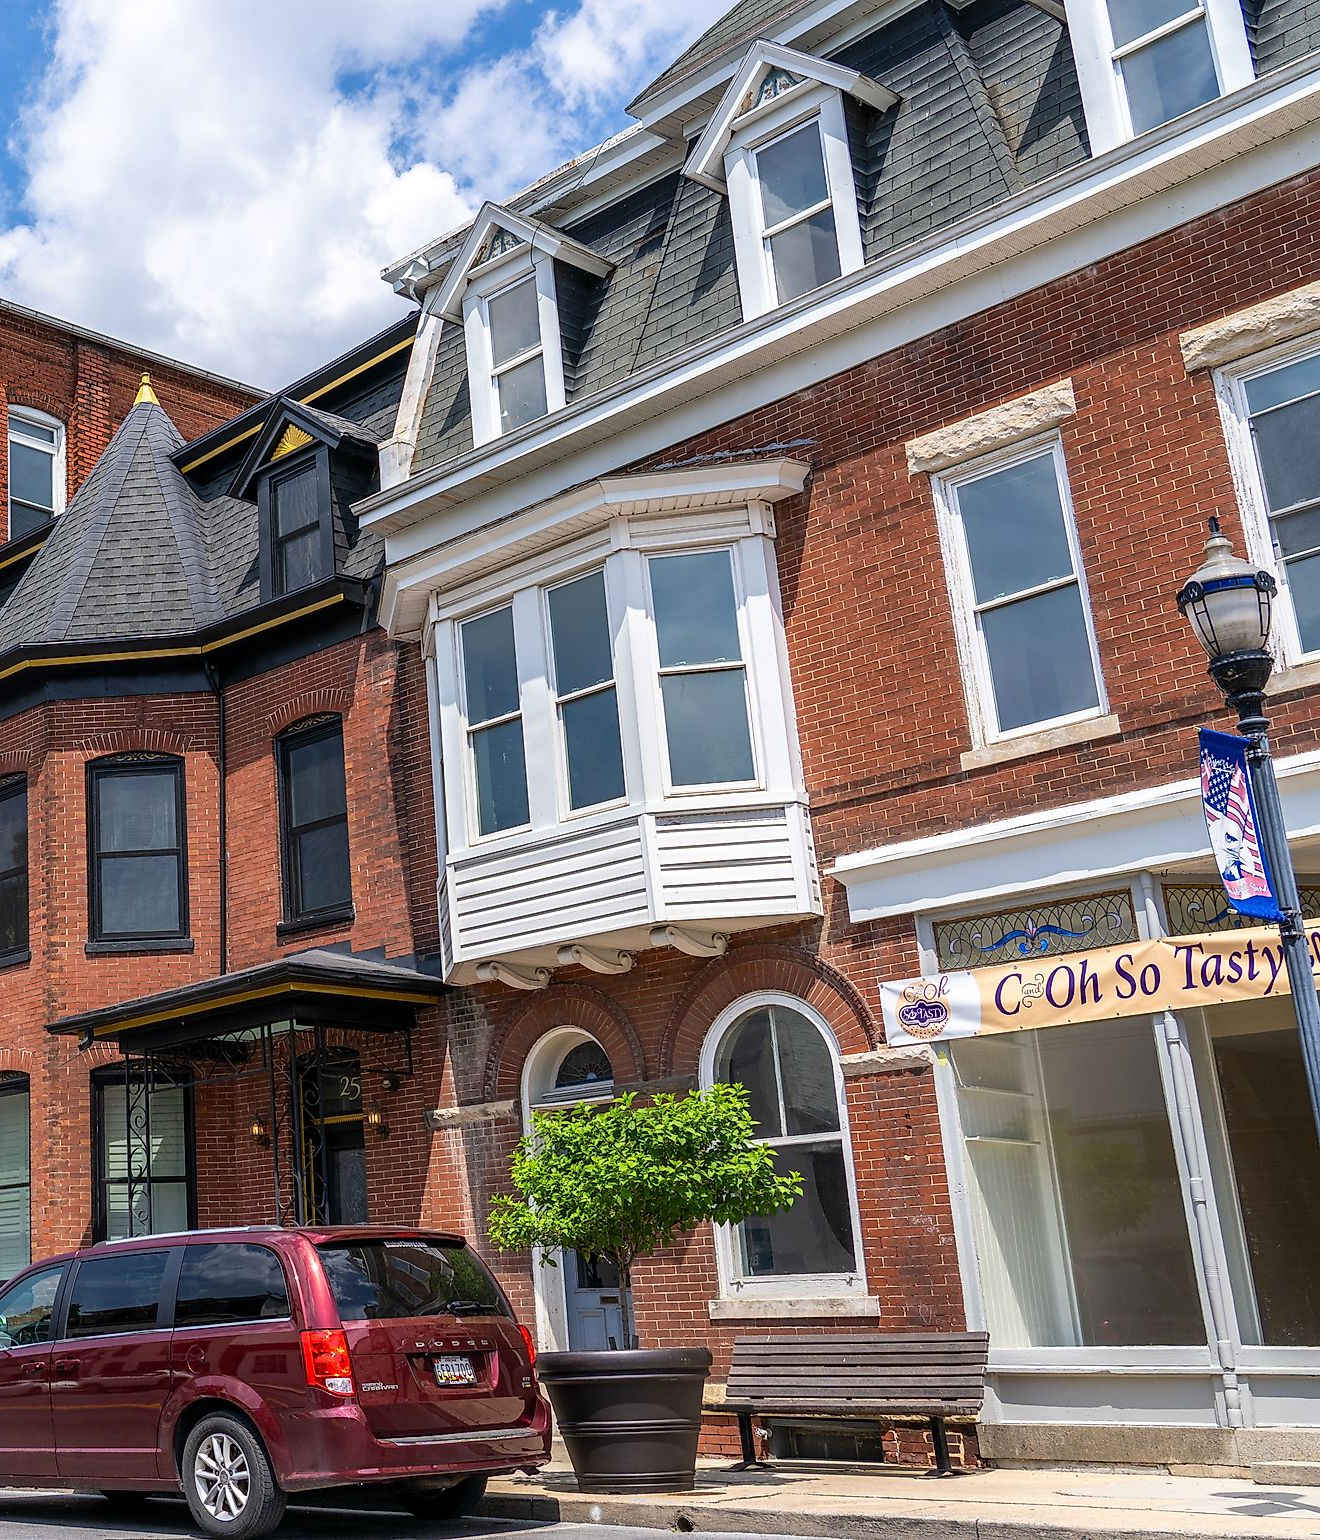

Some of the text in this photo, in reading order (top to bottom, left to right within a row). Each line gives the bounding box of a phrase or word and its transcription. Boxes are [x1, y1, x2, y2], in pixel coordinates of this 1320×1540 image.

[995, 973, 1022, 1015] C
[1046, 959, 1103, 1008] Oh
[1116, 955, 1161, 998] So
[1174, 939, 1284, 995] Tasty
[340, 1076, 360, 1100] 25
[415, 1340, 489, 1348] DODGE
